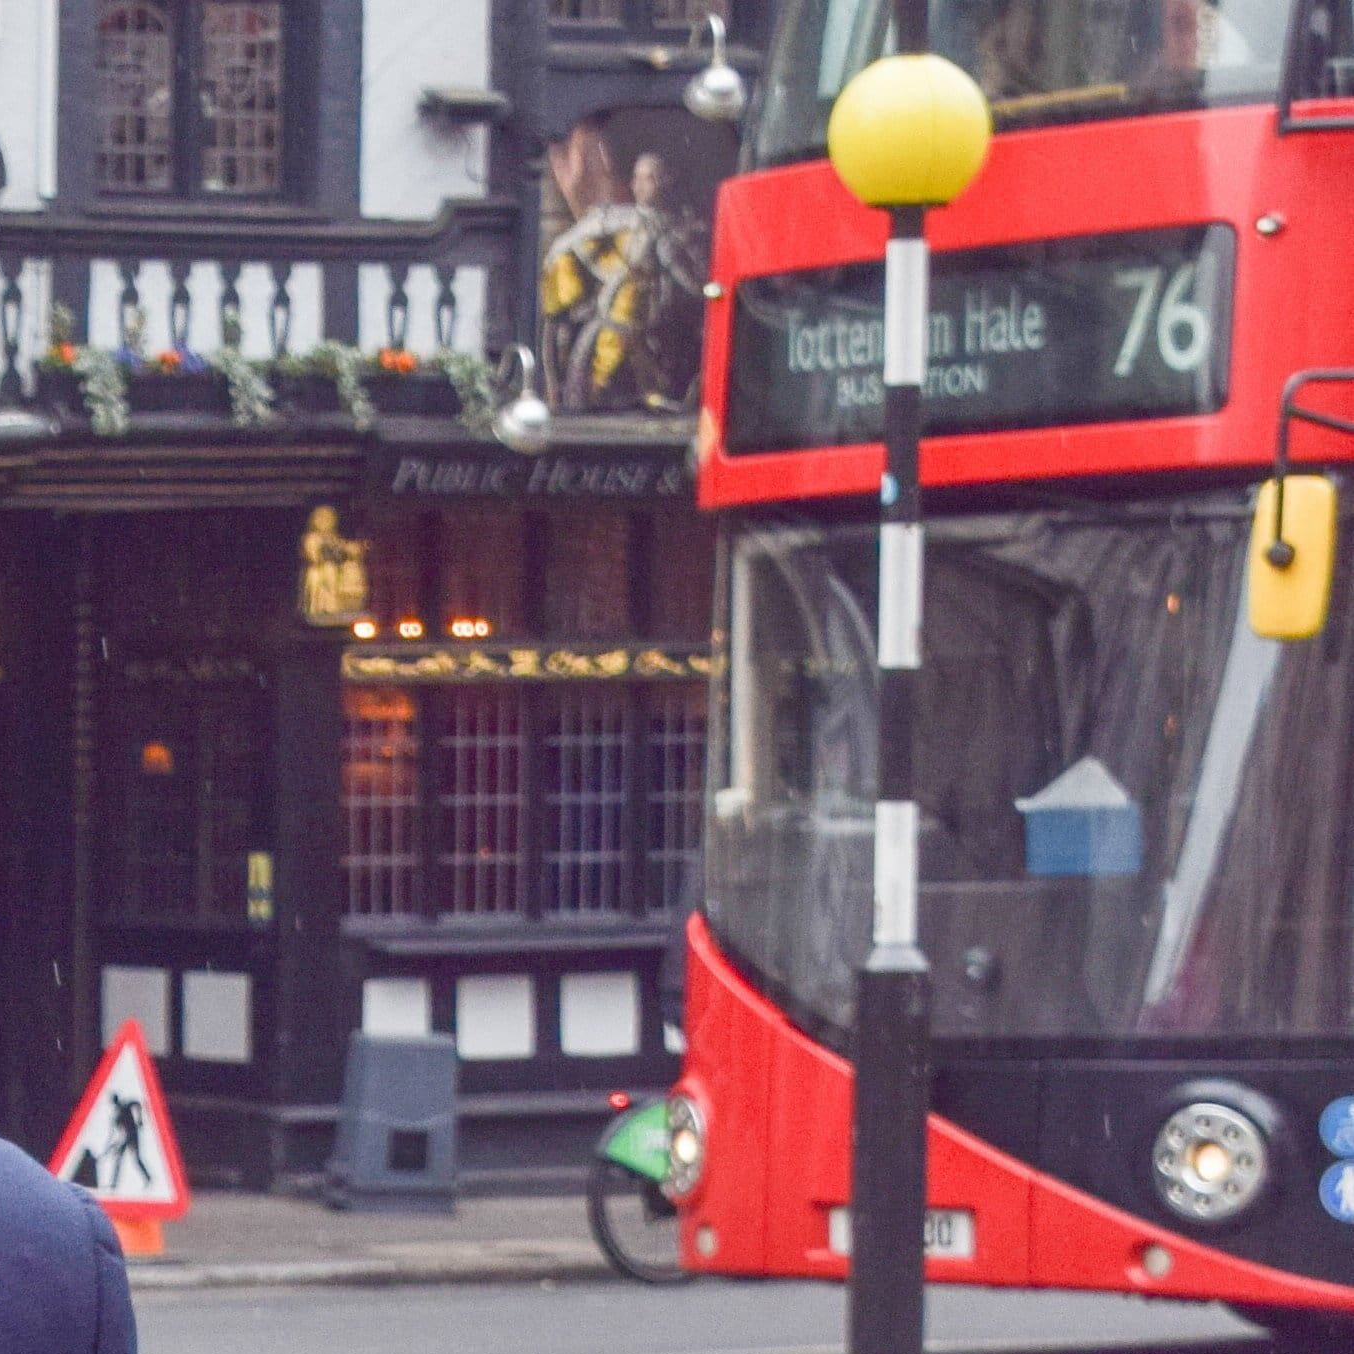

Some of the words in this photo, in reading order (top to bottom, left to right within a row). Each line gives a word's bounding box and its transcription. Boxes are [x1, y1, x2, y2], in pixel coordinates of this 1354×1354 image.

[784, 307, 954, 374] Tottenm
[963, 285, 1048, 353] Hale
[1111, 263, 1211, 379] 76
[835, 371, 886, 408] BUS
